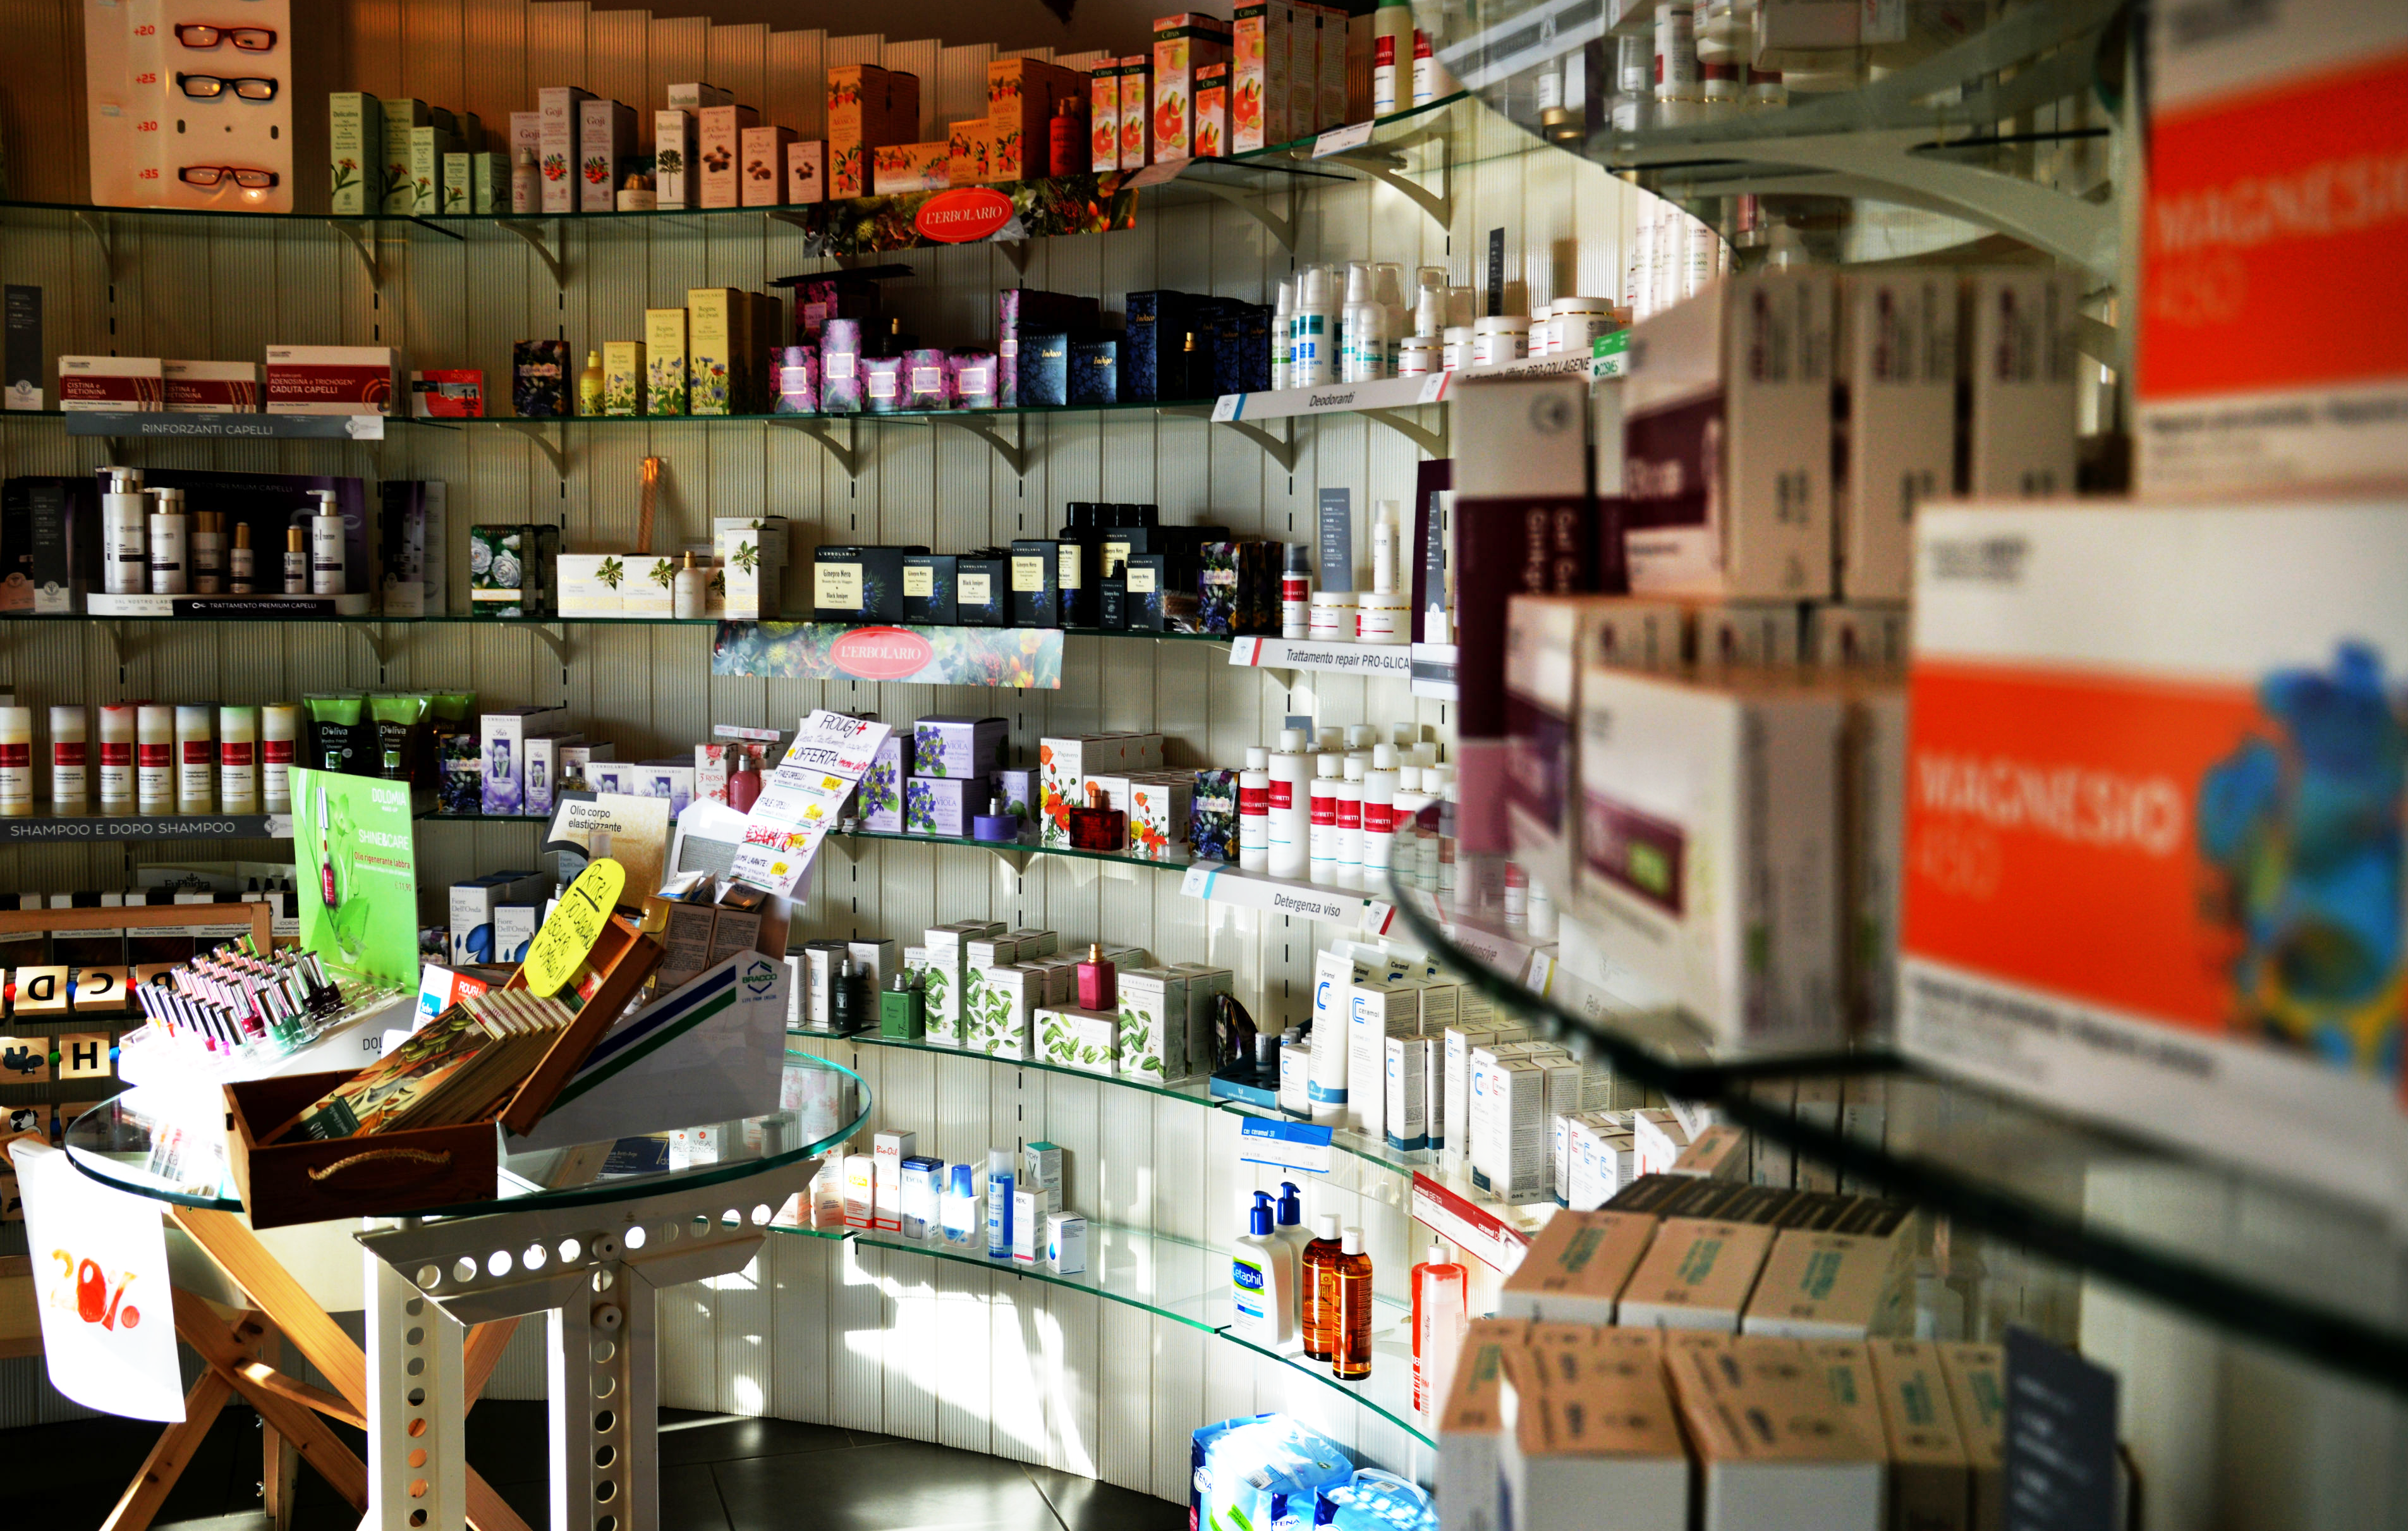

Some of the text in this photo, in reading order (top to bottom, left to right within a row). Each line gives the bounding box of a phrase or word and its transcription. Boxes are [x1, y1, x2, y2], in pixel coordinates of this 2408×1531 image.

[1239, 8, 1258, 17] Citrus
[133, 25, 155, 36] +2.0
[1162, 29, 1180, 39] Citrus
[1202, 79, 1217, 88] Citrus
[545, 107, 562, 118] Goji
[587, 116, 605, 126] Goji
[138, 169, 159, 179] +3.5
[925, 205, 1002, 226] L'ERBOLARIO
[271, 386, 303, 394] CADUTA
[1310, 391, 1356, 408] Deodoranti
[142, 424, 273, 435] RINFORZANTI CAPELLI
[824, 569, 851, 578] Ginepro Nero
[841, 644, 922, 662] L'ERBOLARIO
[1287, 649, 1410, 670] Trattamento repair PRO-GLICA
[946, 741, 968, 750] VIOLA
[794, 747, 839, 767] OFFERTA
[1058, 750, 1079, 760] Papavero
[372, 788, 406, 806] DOLOMIA
[936, 797, 956, 806] VIOLA
[1918, 751, 2185, 857] MAGNESIO
[570, 805, 611, 820] Olio corpo
[11, 822, 235, 836] SHAMPOO E DOPO SHAMPOO
[569, 819, 622, 833] elasticizzante
[358, 829, 410, 851] SHINE&CARE
[354, 851, 410, 869] Olio rigenerante labbra
[451, 905, 482, 913] Dell'Onda
[1275, 893, 1341, 917] Detergenza viso
[497, 925, 530, 934] Dell'Onda
[1354, 965, 1370, 977] Ceramol
[1390, 961, 1410, 972] Ceramol
[742, 973, 777, 984] BRACCO
[1321, 969, 1335, 979] Ceramol
[1359, 1008, 1380, 1018] ceramol
[1387, 1044, 1401, 1054] Ceramol
[73, 1042, 98, 1070] H
[1475, 1057, 1488, 1068] Ceramol
[1251, 1129, 1268, 1137] ceramol
[877, 1145, 898, 1157] Bio-Oil
[1026, 1150, 1038, 1161] VICHY
[906, 1175, 923, 1185] LYCIA
[1414, 1183, 1442, 1205] ceramol BETA
[1478, 1223, 1495, 1236] ceramol
[1232, 1264, 1263, 1288] Cetaphil
[1195, 1469, 1213, 1492] TENA
[1273, 1518, 1301, 1527] TENA
